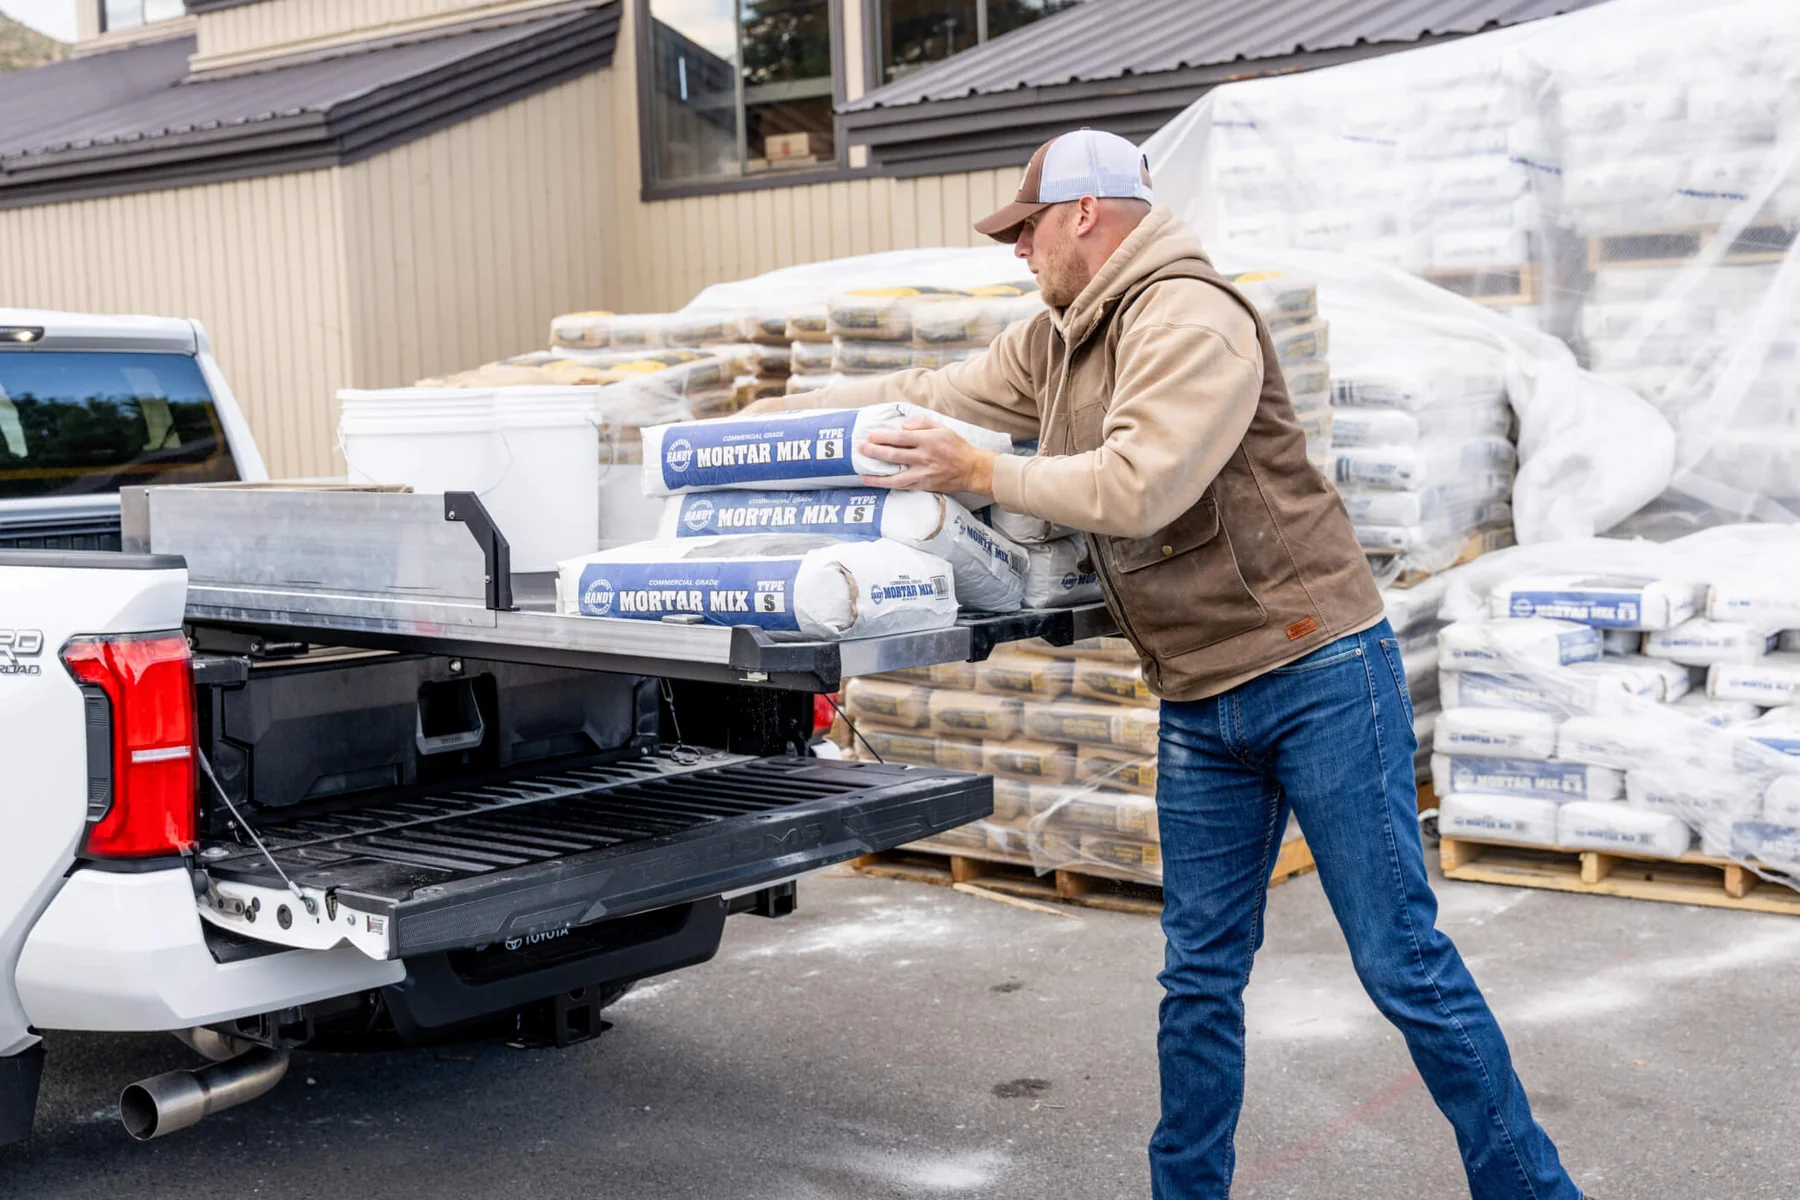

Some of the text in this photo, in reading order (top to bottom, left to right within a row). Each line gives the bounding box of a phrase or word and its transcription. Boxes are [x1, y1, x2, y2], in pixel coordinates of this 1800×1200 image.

[723, 431, 784, 442] COMMERCIAL GRADE
[818, 428, 845, 439] TYPE
[666, 449, 693, 464] HANDY
[696, 440, 812, 469] MORTAR MIX
[824, 440, 835, 458] S
[850, 495, 877, 505] TYPE
[717, 505, 841, 528] MORTAR MIX
[853, 507, 865, 523] S
[756, 580, 785, 591] TYPE
[883, 583, 934, 600] MORTAR MIX
[584, 591, 615, 605] HANDY
[619, 590, 750, 613] MORTAR MIX
[764, 593, 775, 612] S
[0, 629, 44, 666] RD
[526, 928, 569, 945] TOYOTA
